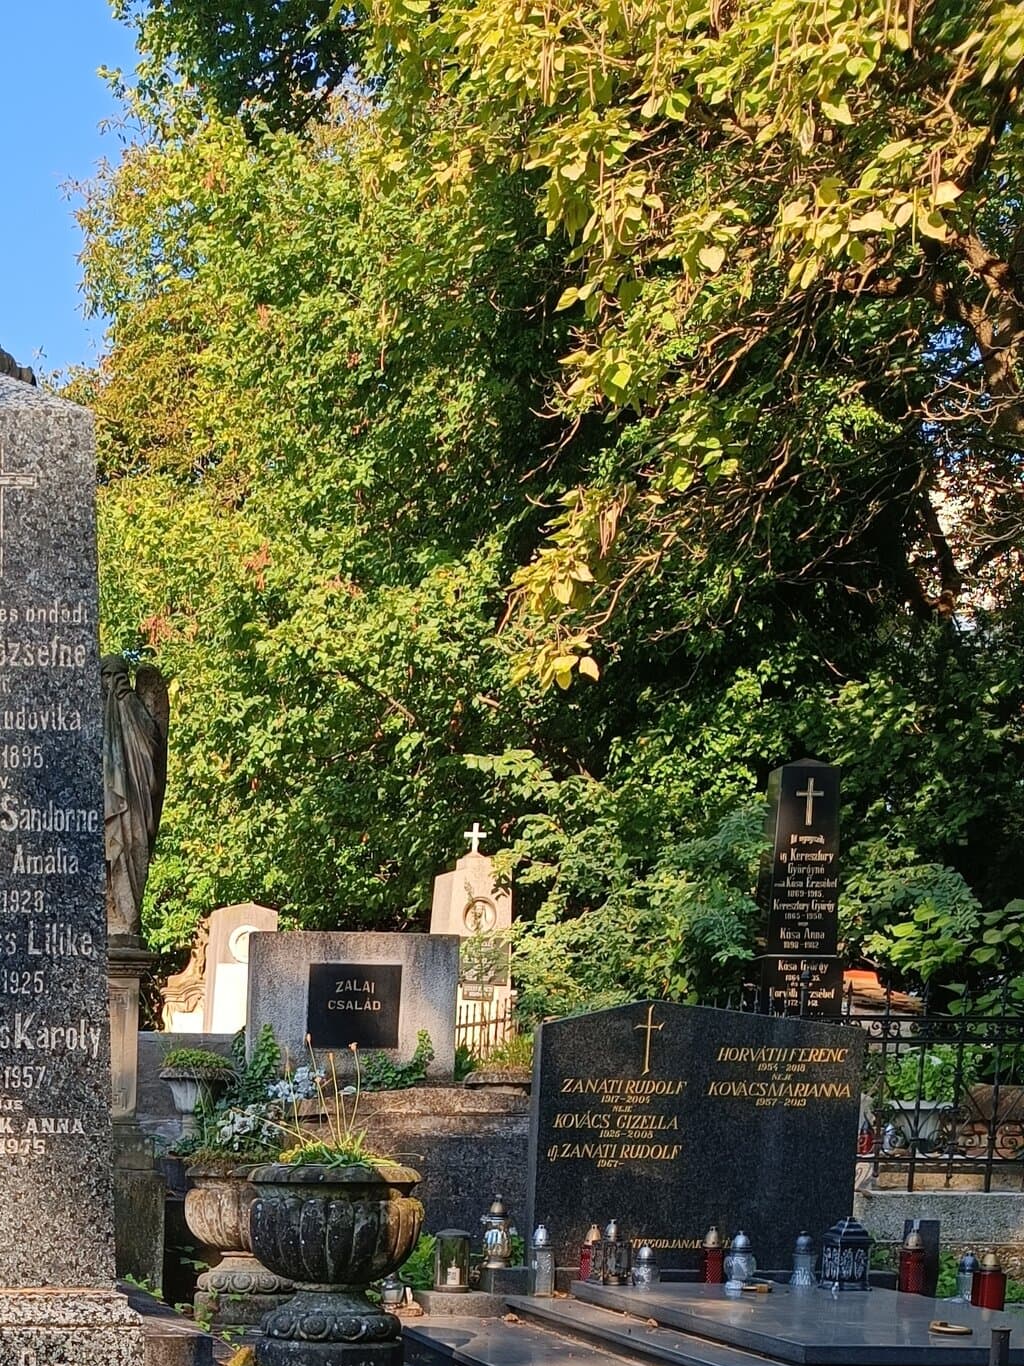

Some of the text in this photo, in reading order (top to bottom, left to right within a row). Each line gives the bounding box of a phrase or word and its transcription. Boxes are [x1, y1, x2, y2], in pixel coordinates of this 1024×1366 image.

[13, 844, 79, 875] Amália
[28, 921, 94, 956] Lilike
[335, 979, 376, 994] ZALAI
[327, 997, 382, 1011] CSALÁD
[14, 1012, 101, 1059] Károly
[716, 1045, 849, 1063] HORVÁTH FERENC
[625, 1080, 687, 1095] RUDOLF
[708, 1079, 852, 1098] KOVÁCS MARIANNA
[25, 1117, 86, 1135] ANNA
[552, 1110, 679, 1130] KOVÁCS GIZELLA
[619, 1144, 683, 1160] RUDOLF
